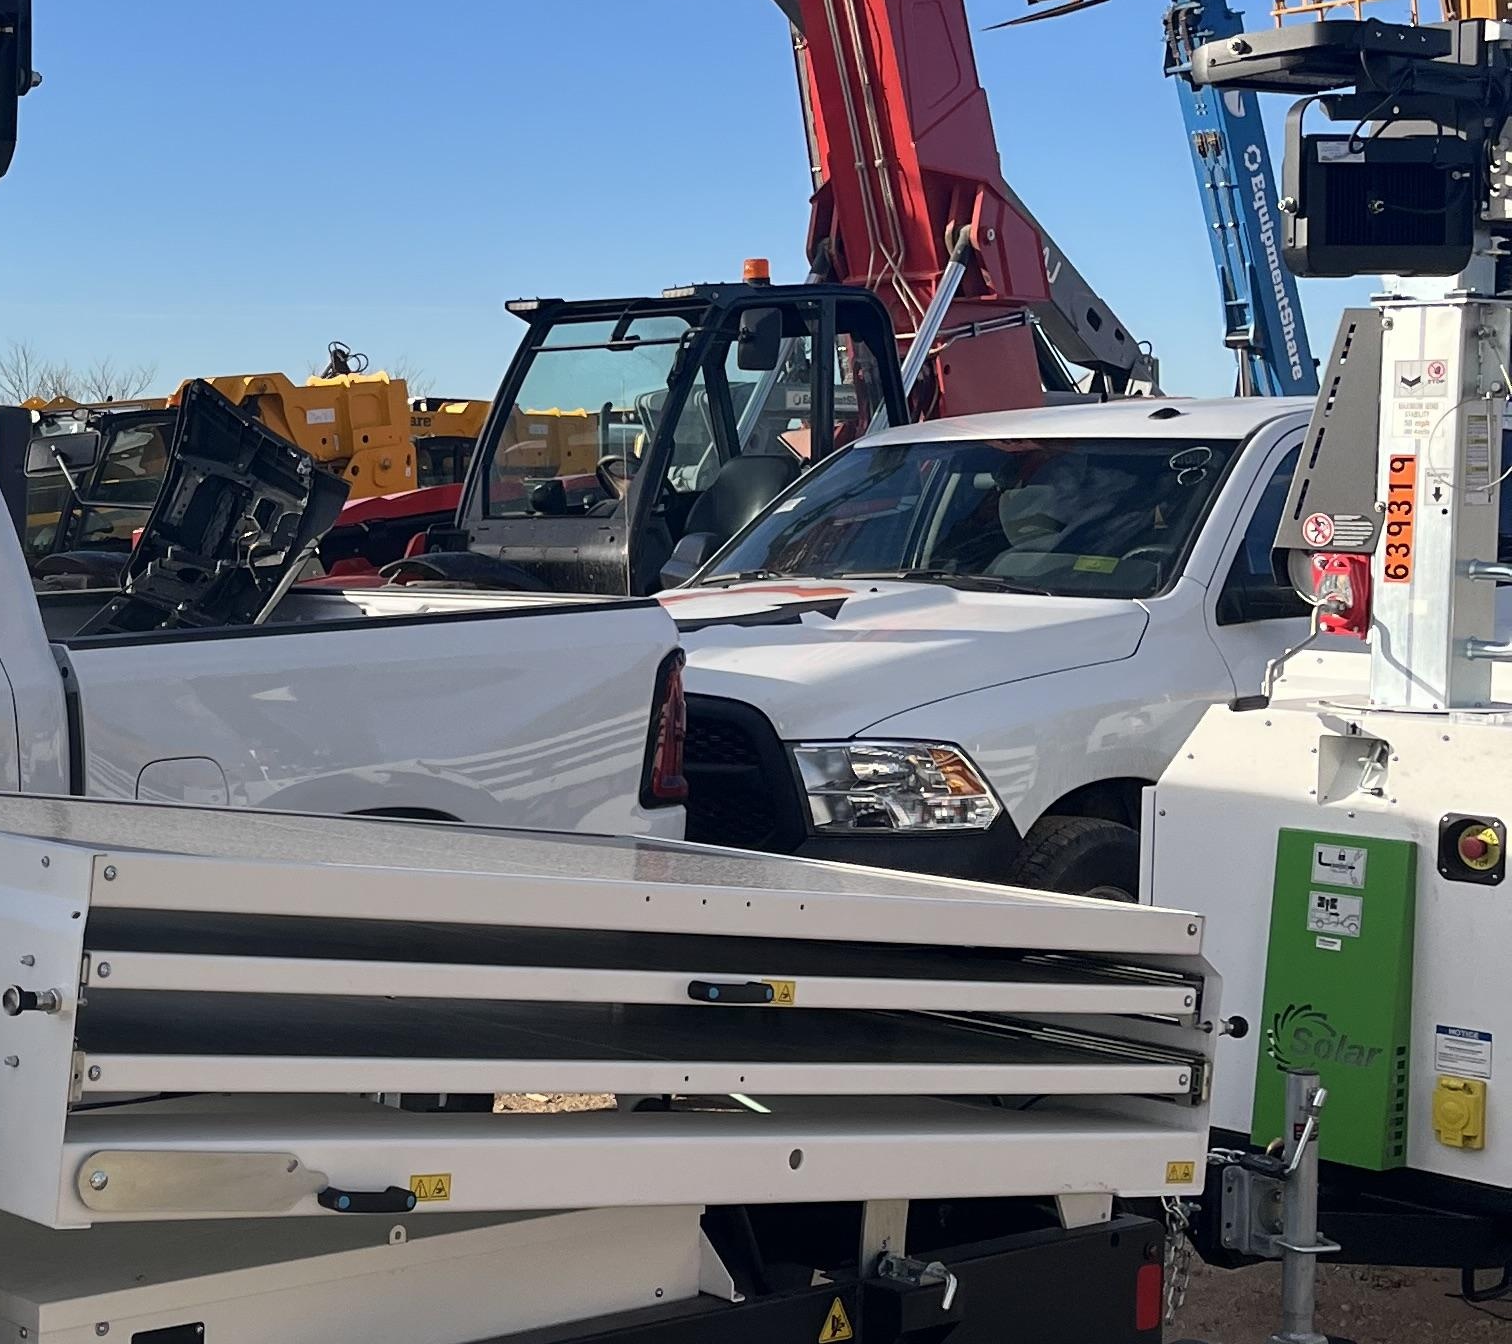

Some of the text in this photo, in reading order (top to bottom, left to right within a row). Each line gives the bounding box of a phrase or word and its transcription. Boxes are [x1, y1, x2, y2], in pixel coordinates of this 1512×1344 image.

[1250, 172, 1303, 381] EquipmentShare
[1384, 457, 1415, 580] 639319
[1290, 1027, 1384, 1068] Solar
[1448, 1027, 1480, 1040] NOTICE
